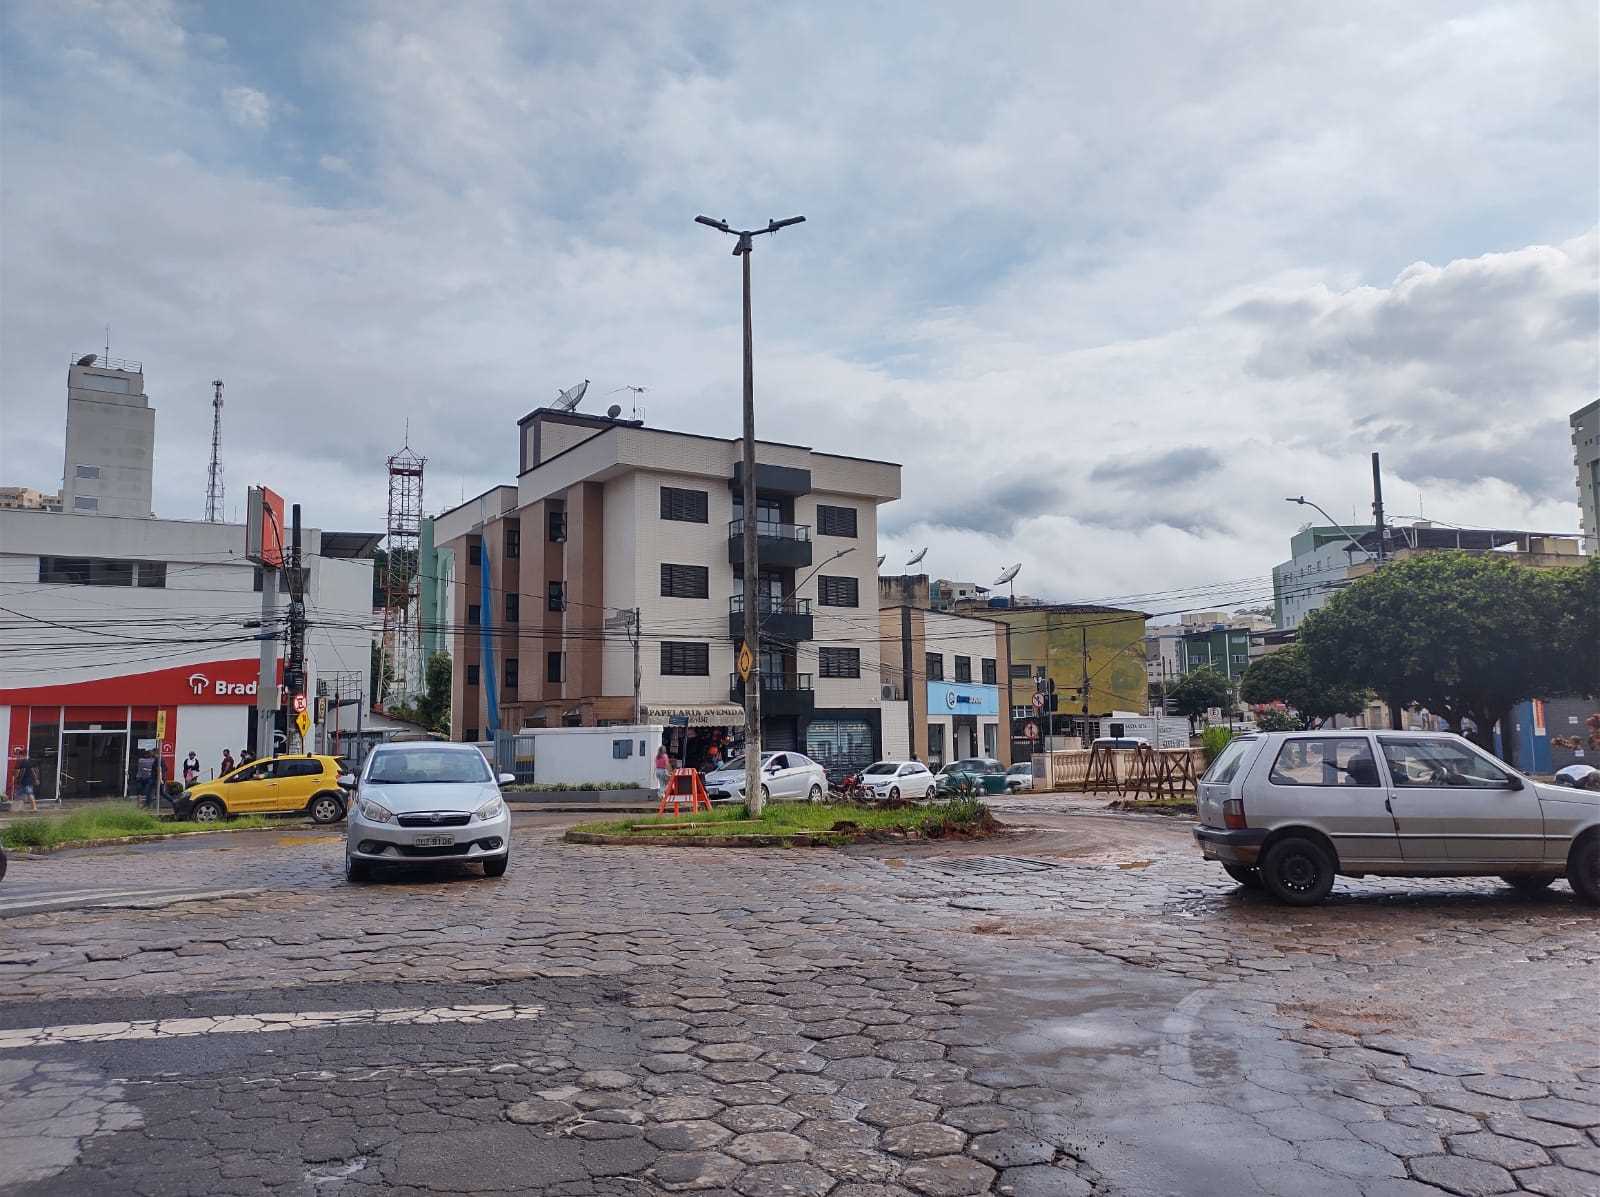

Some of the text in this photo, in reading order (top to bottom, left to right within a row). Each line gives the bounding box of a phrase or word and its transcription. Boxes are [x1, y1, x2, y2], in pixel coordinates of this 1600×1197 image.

[215, 680, 290, 698] Brad
[649, 707, 744, 717] PAPELARIA AVENIDA
